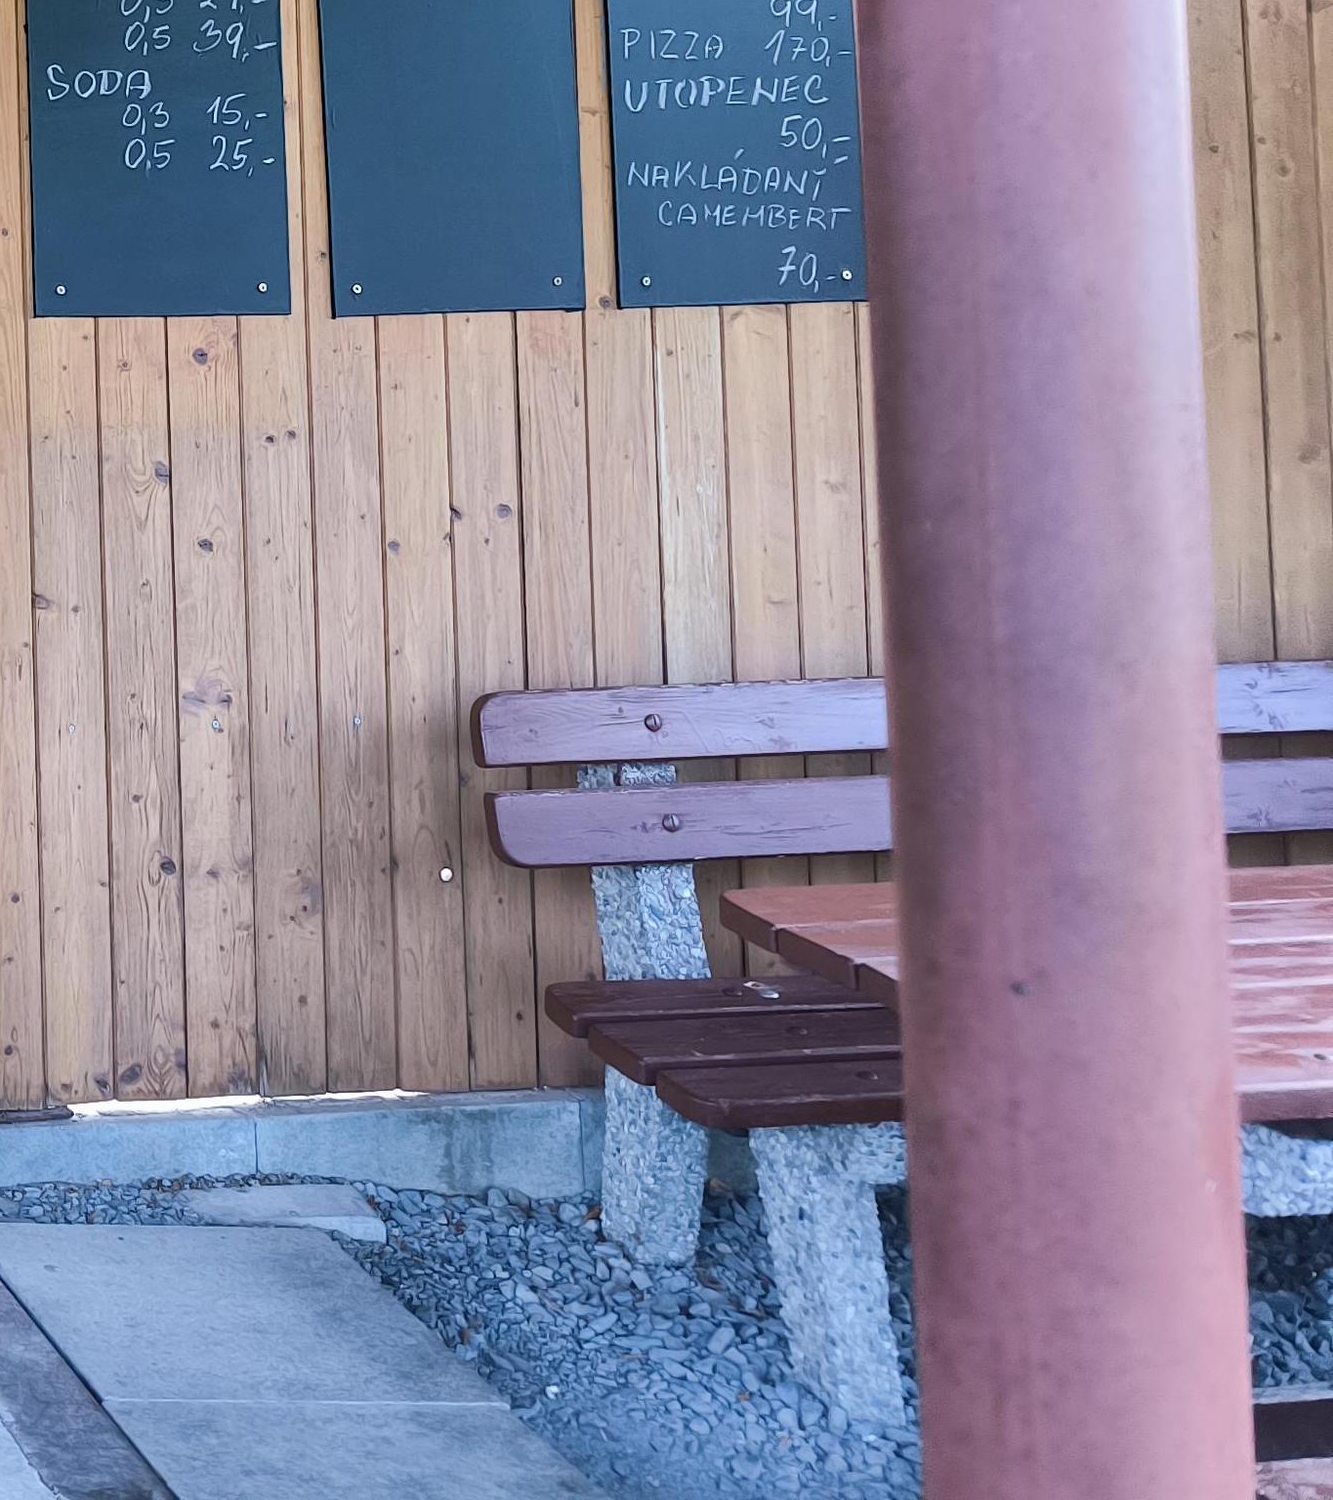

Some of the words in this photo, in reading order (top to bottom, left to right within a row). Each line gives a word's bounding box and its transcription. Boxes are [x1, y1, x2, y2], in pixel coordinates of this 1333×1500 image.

[123, 21, 172, 57] 0,5
[619, 28, 726, 61] PIZZA
[46, 64, 153, 101] SODA
[623, 74, 831, 113] UTOPENEC
[122, 101, 171, 136] 0,3
[123, 138, 176, 177] 0,5
[657, 199, 853, 231] CAMEMBERT
